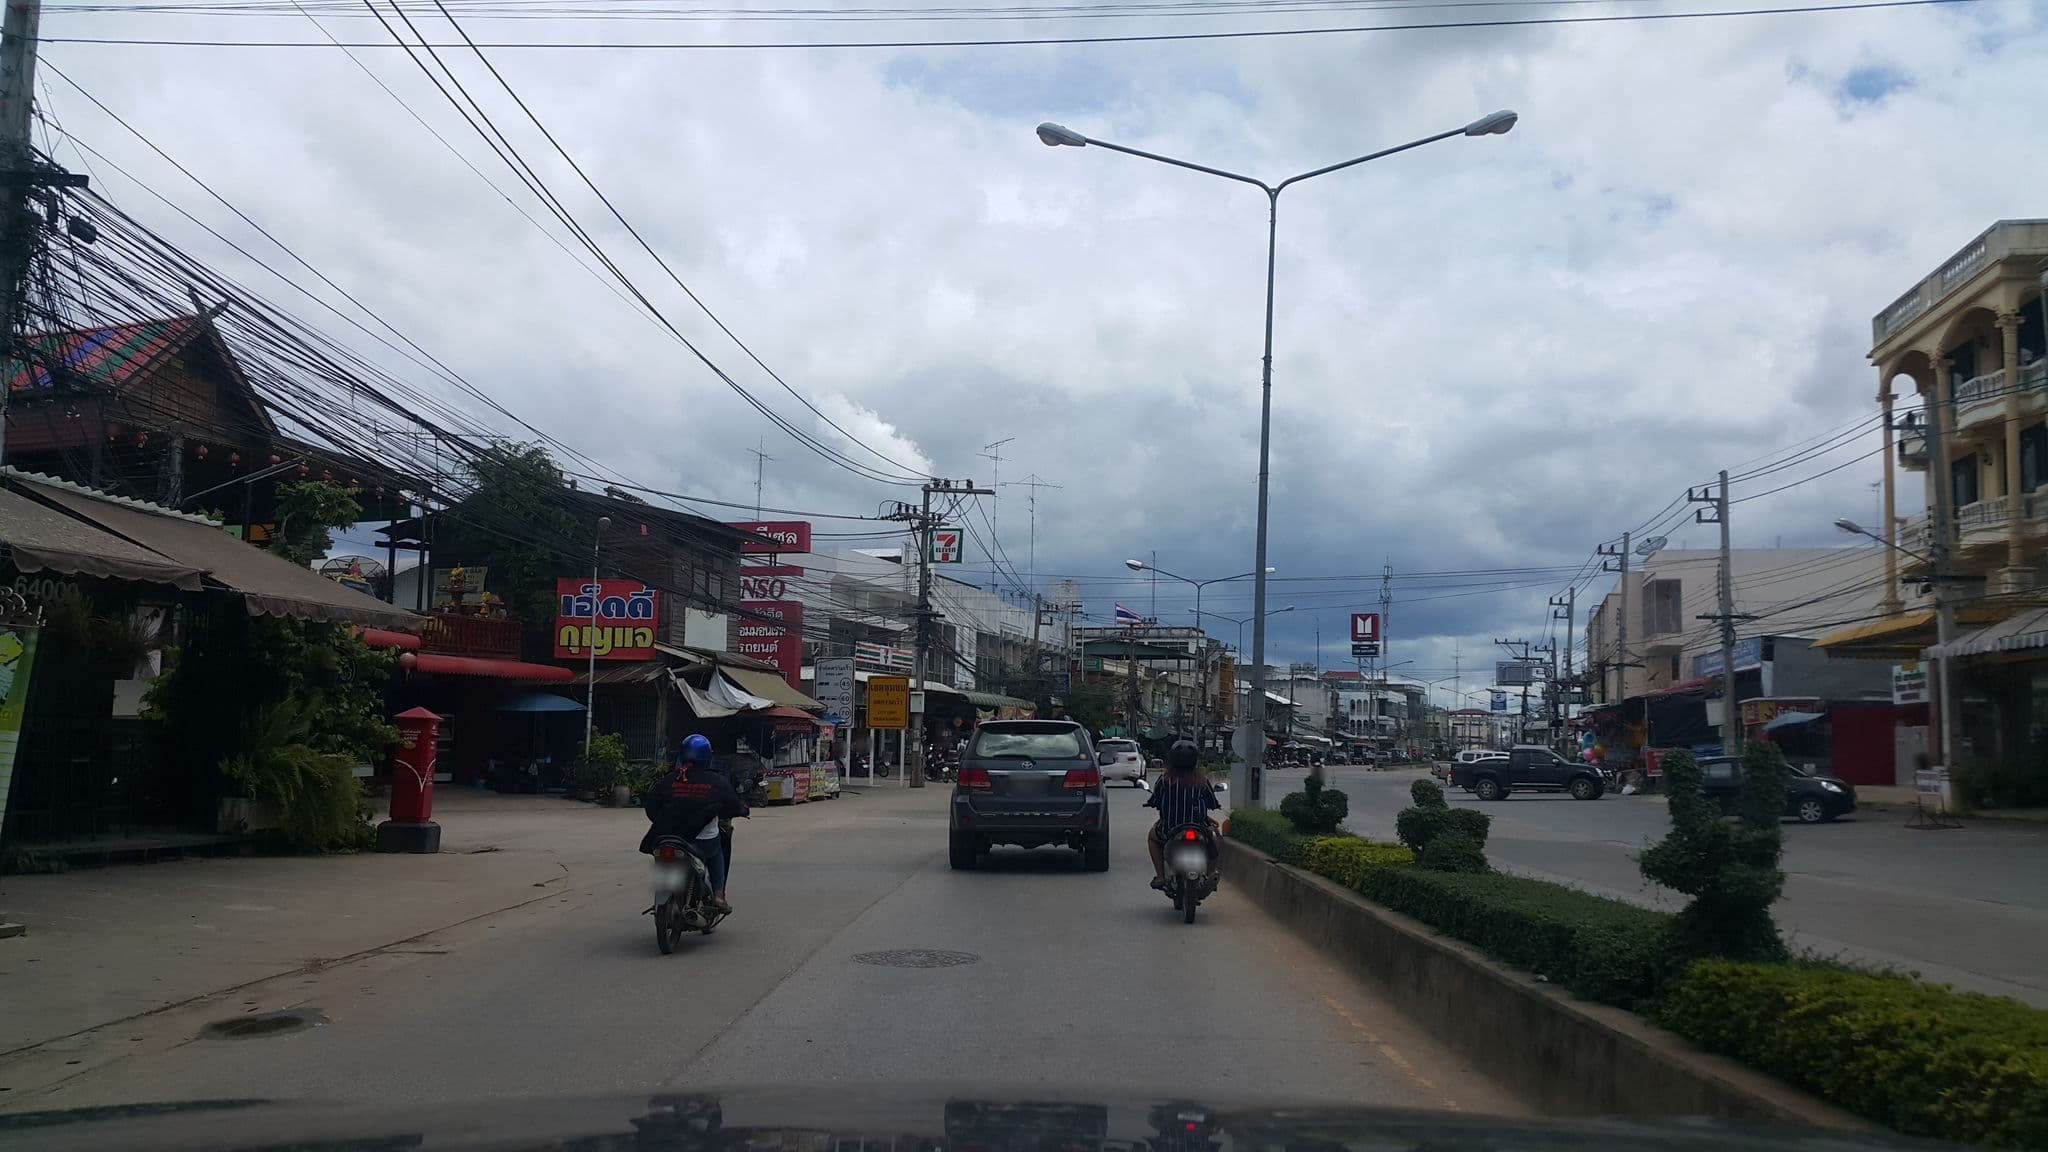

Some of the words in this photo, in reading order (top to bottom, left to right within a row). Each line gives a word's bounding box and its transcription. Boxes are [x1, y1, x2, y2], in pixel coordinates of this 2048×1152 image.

[561, 584, 656, 620] เอ็ดดี้
[559, 624, 655, 657] กุญแจ
[841, 709, 850, 717] 70
